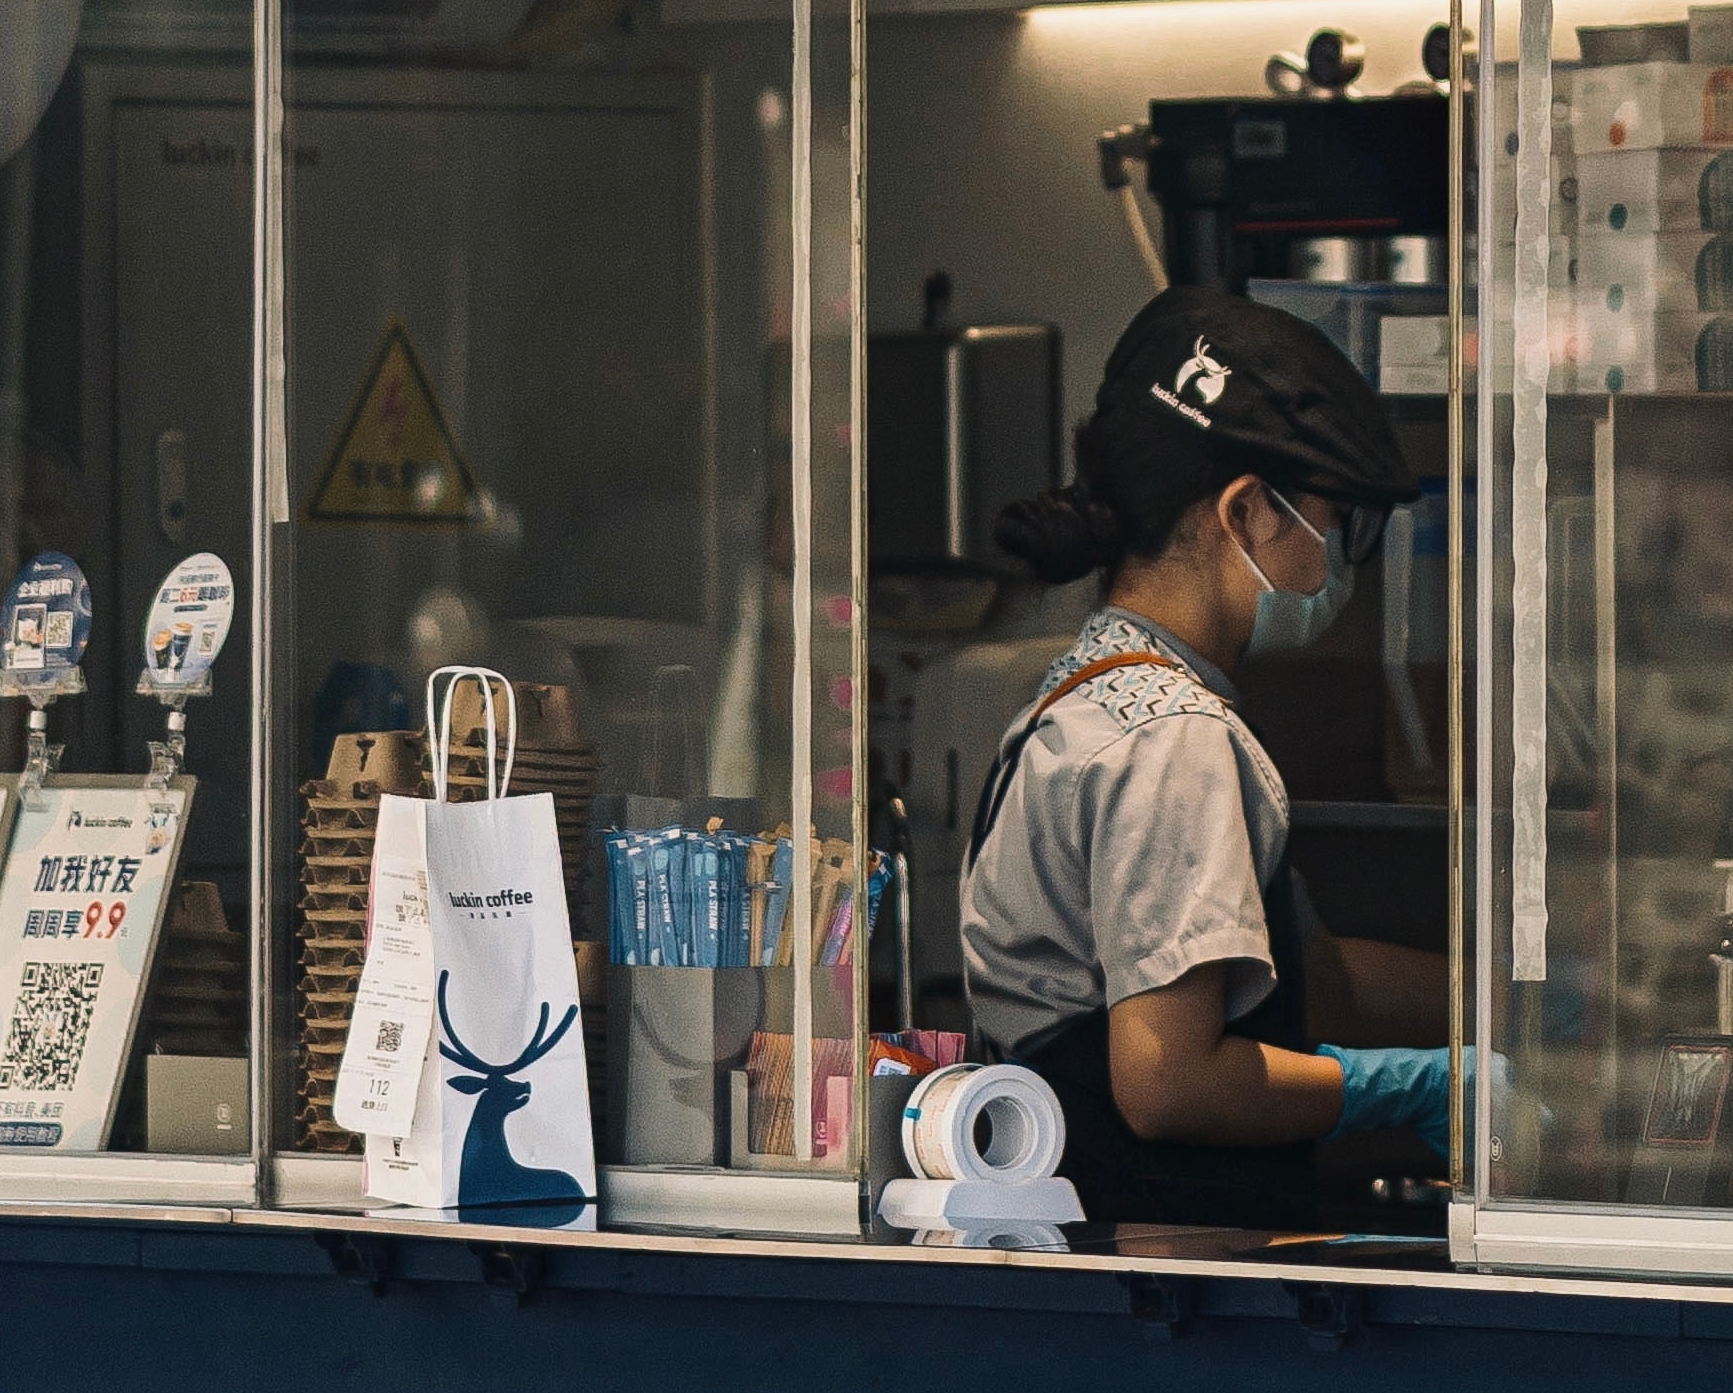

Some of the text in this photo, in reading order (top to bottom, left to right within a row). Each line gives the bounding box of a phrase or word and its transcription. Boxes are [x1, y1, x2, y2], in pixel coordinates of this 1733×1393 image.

[33, 854, 143, 893] 加我好友
[448, 888, 534, 908] luckin coffee
[708, 899, 718, 931] STRAW
[369, 1078, 391, 1096] 112
